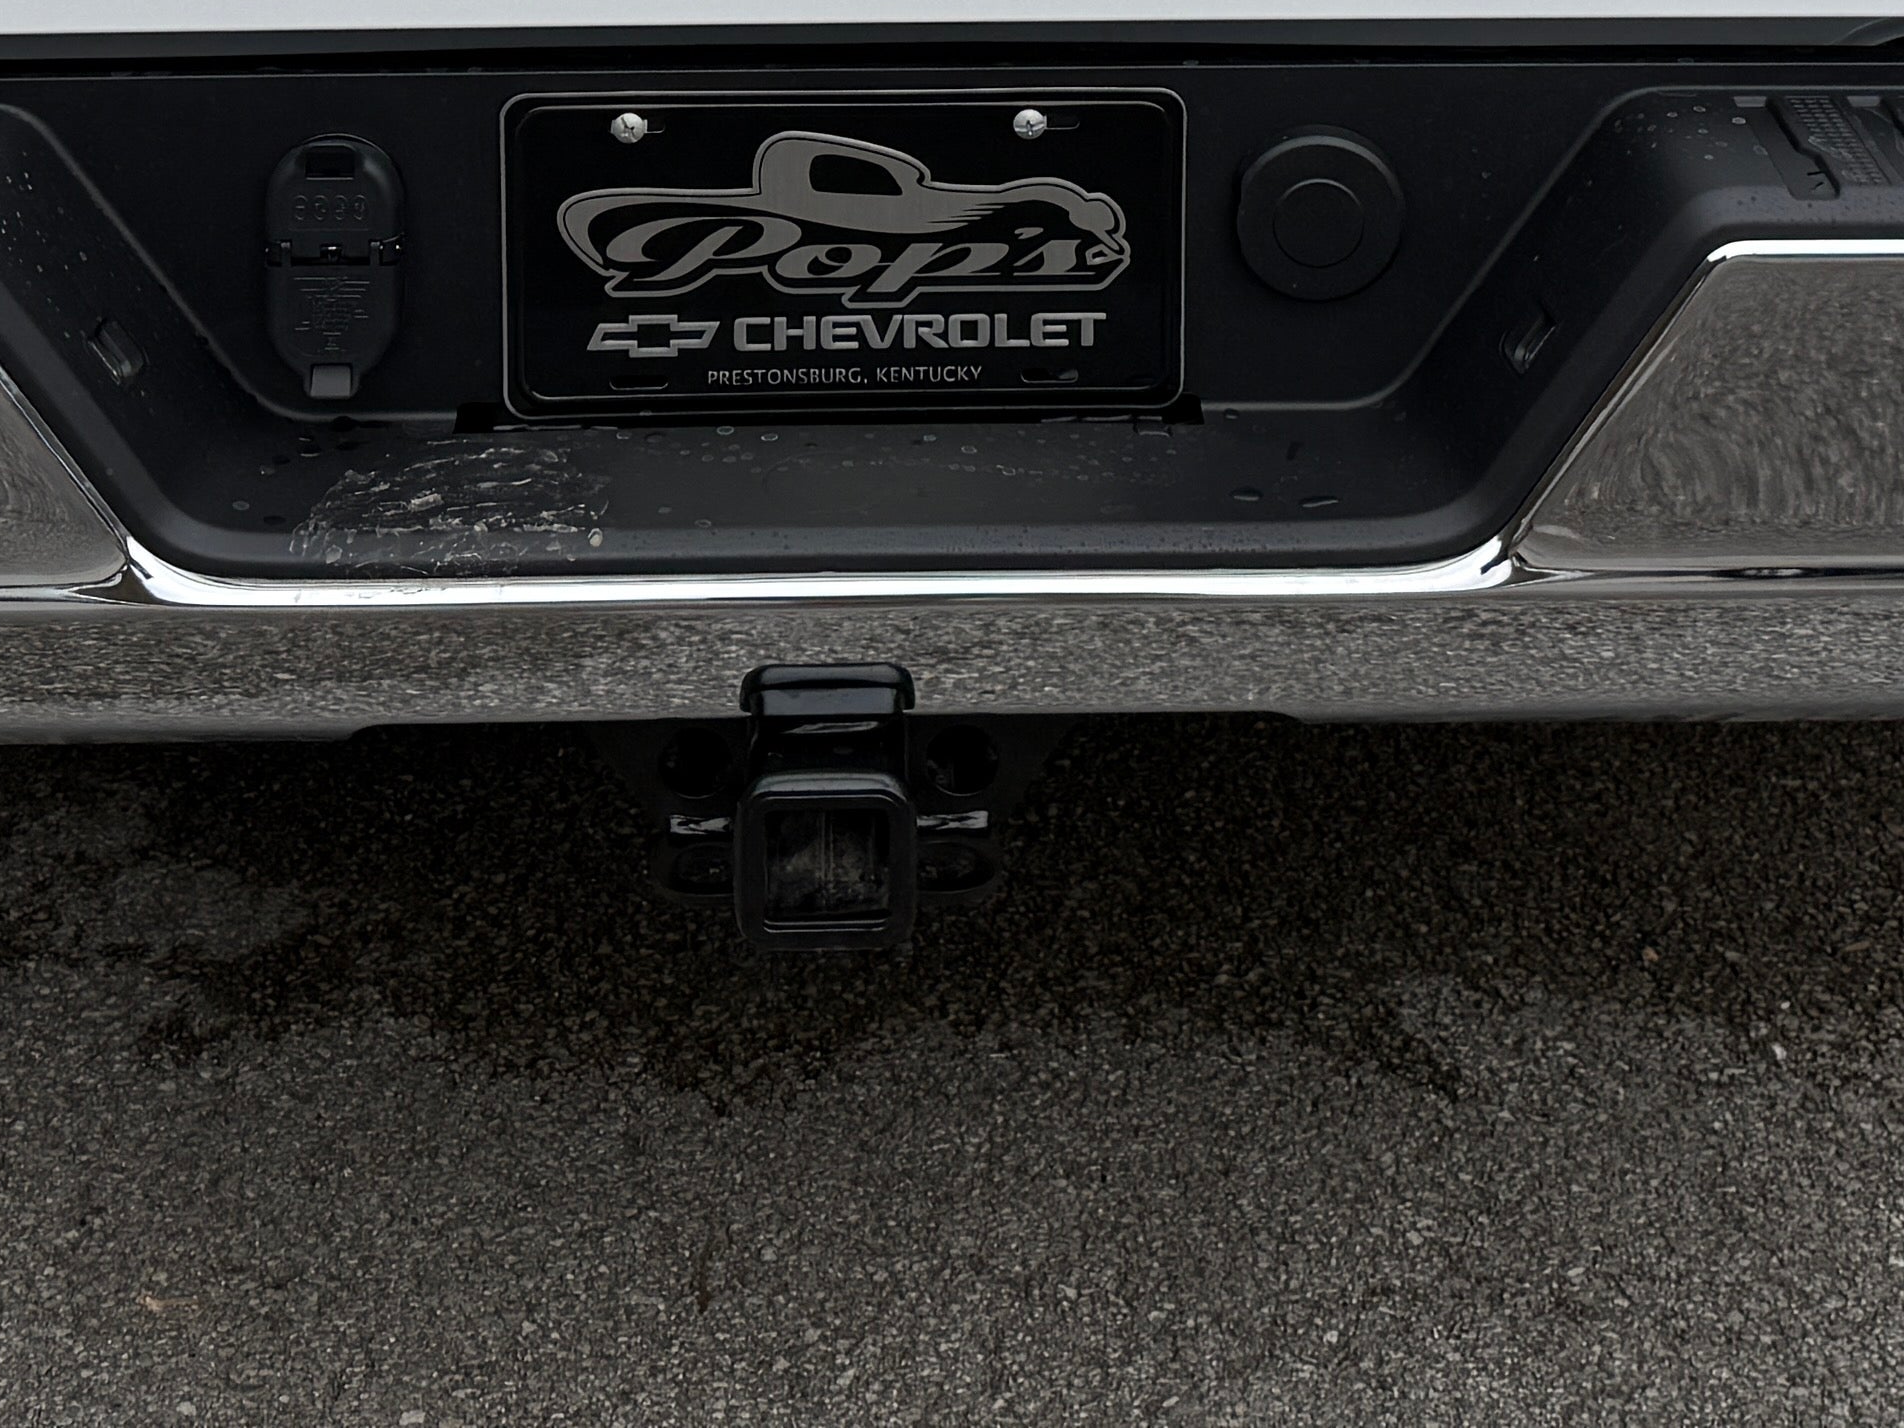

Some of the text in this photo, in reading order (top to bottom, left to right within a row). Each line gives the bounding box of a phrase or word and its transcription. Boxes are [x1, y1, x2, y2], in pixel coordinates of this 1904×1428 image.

[732, 311, 1107, 352] CHEVROLET
[706, 364, 983, 387] PRESTONSBURG, KENTUCKY
